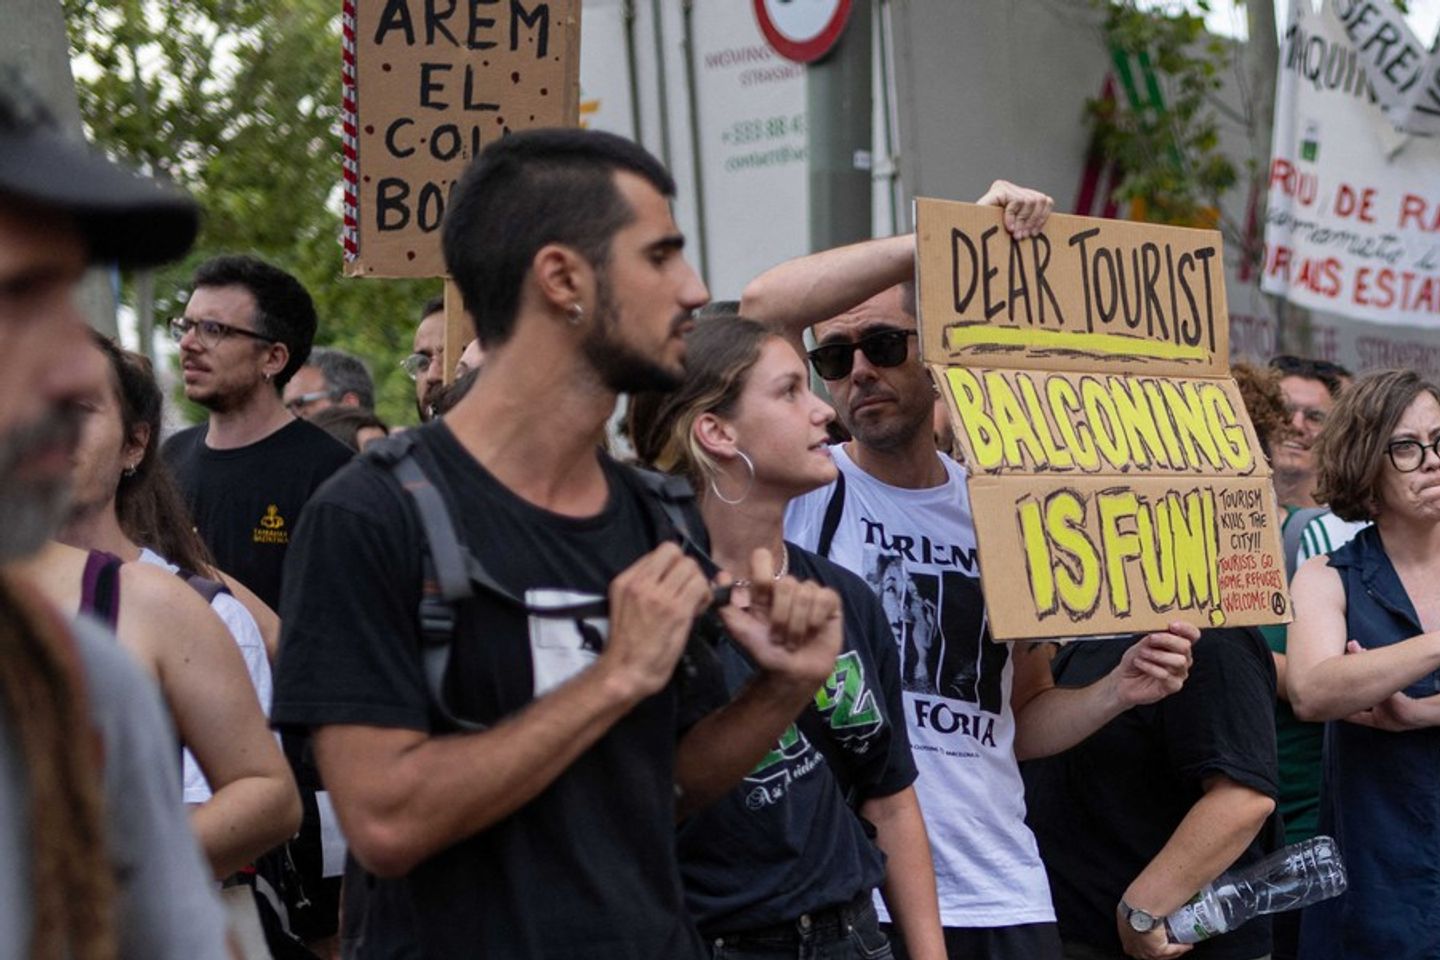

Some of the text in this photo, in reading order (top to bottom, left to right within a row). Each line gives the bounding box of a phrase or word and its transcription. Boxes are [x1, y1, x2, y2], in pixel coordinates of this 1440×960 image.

[419, 62, 500, 111] EL
[376, 177, 457, 233] BO
[1333, 182, 1377, 223] DE
[951, 224, 1064, 325] DEAR
[1069, 228, 1216, 353] TOURIST
[944, 366, 1257, 476] BALCONING
[1219, 488, 1263, 511] TOURISM
[1249, 511, 1267, 528] THE
[1016, 486, 1102, 624] IS
[1220, 552, 1273, 573] TOURISTS GO
[1230, 531, 1261, 553] CITY!!
[1223, 590, 1271, 612] WELCOME!
